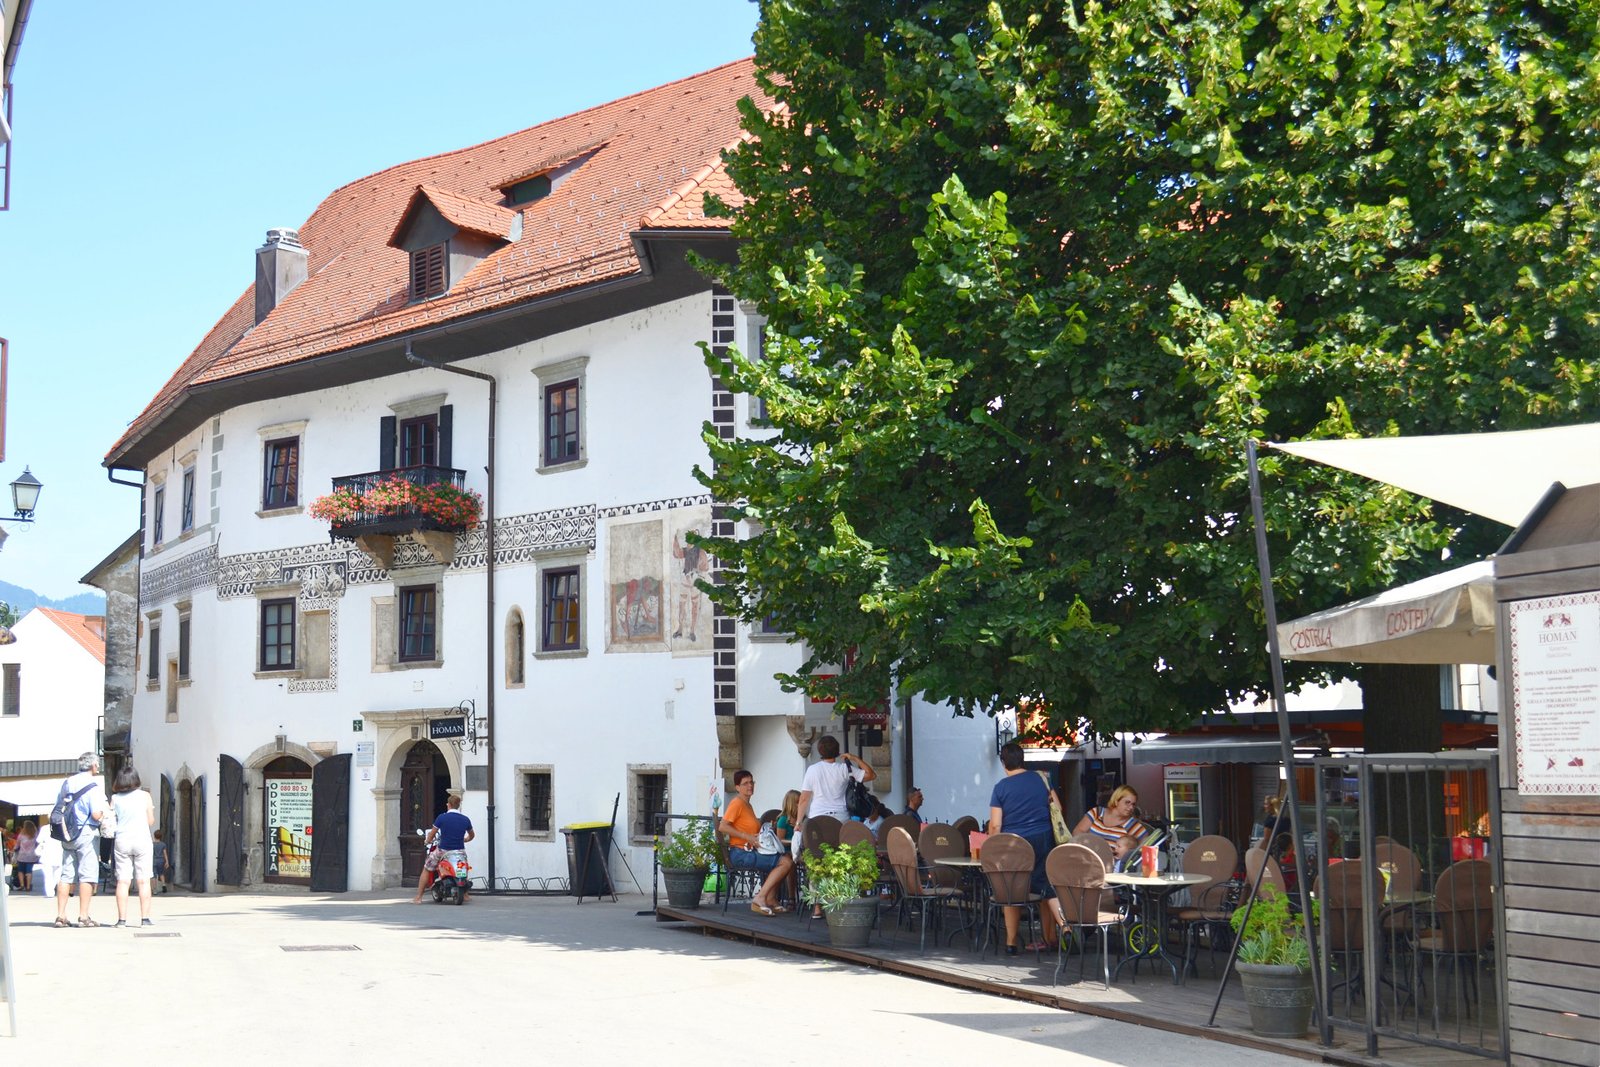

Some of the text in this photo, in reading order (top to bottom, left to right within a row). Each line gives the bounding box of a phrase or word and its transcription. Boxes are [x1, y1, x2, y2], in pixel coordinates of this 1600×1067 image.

[1289, 626, 1333, 651] COSTELLA
[1539, 630, 1577, 643] HOMAN
[432, 725, 464, 735] HOMAN
[269, 782, 278, 871] ODKUP ZLATA
[280, 864, 300, 873] ODKUP
